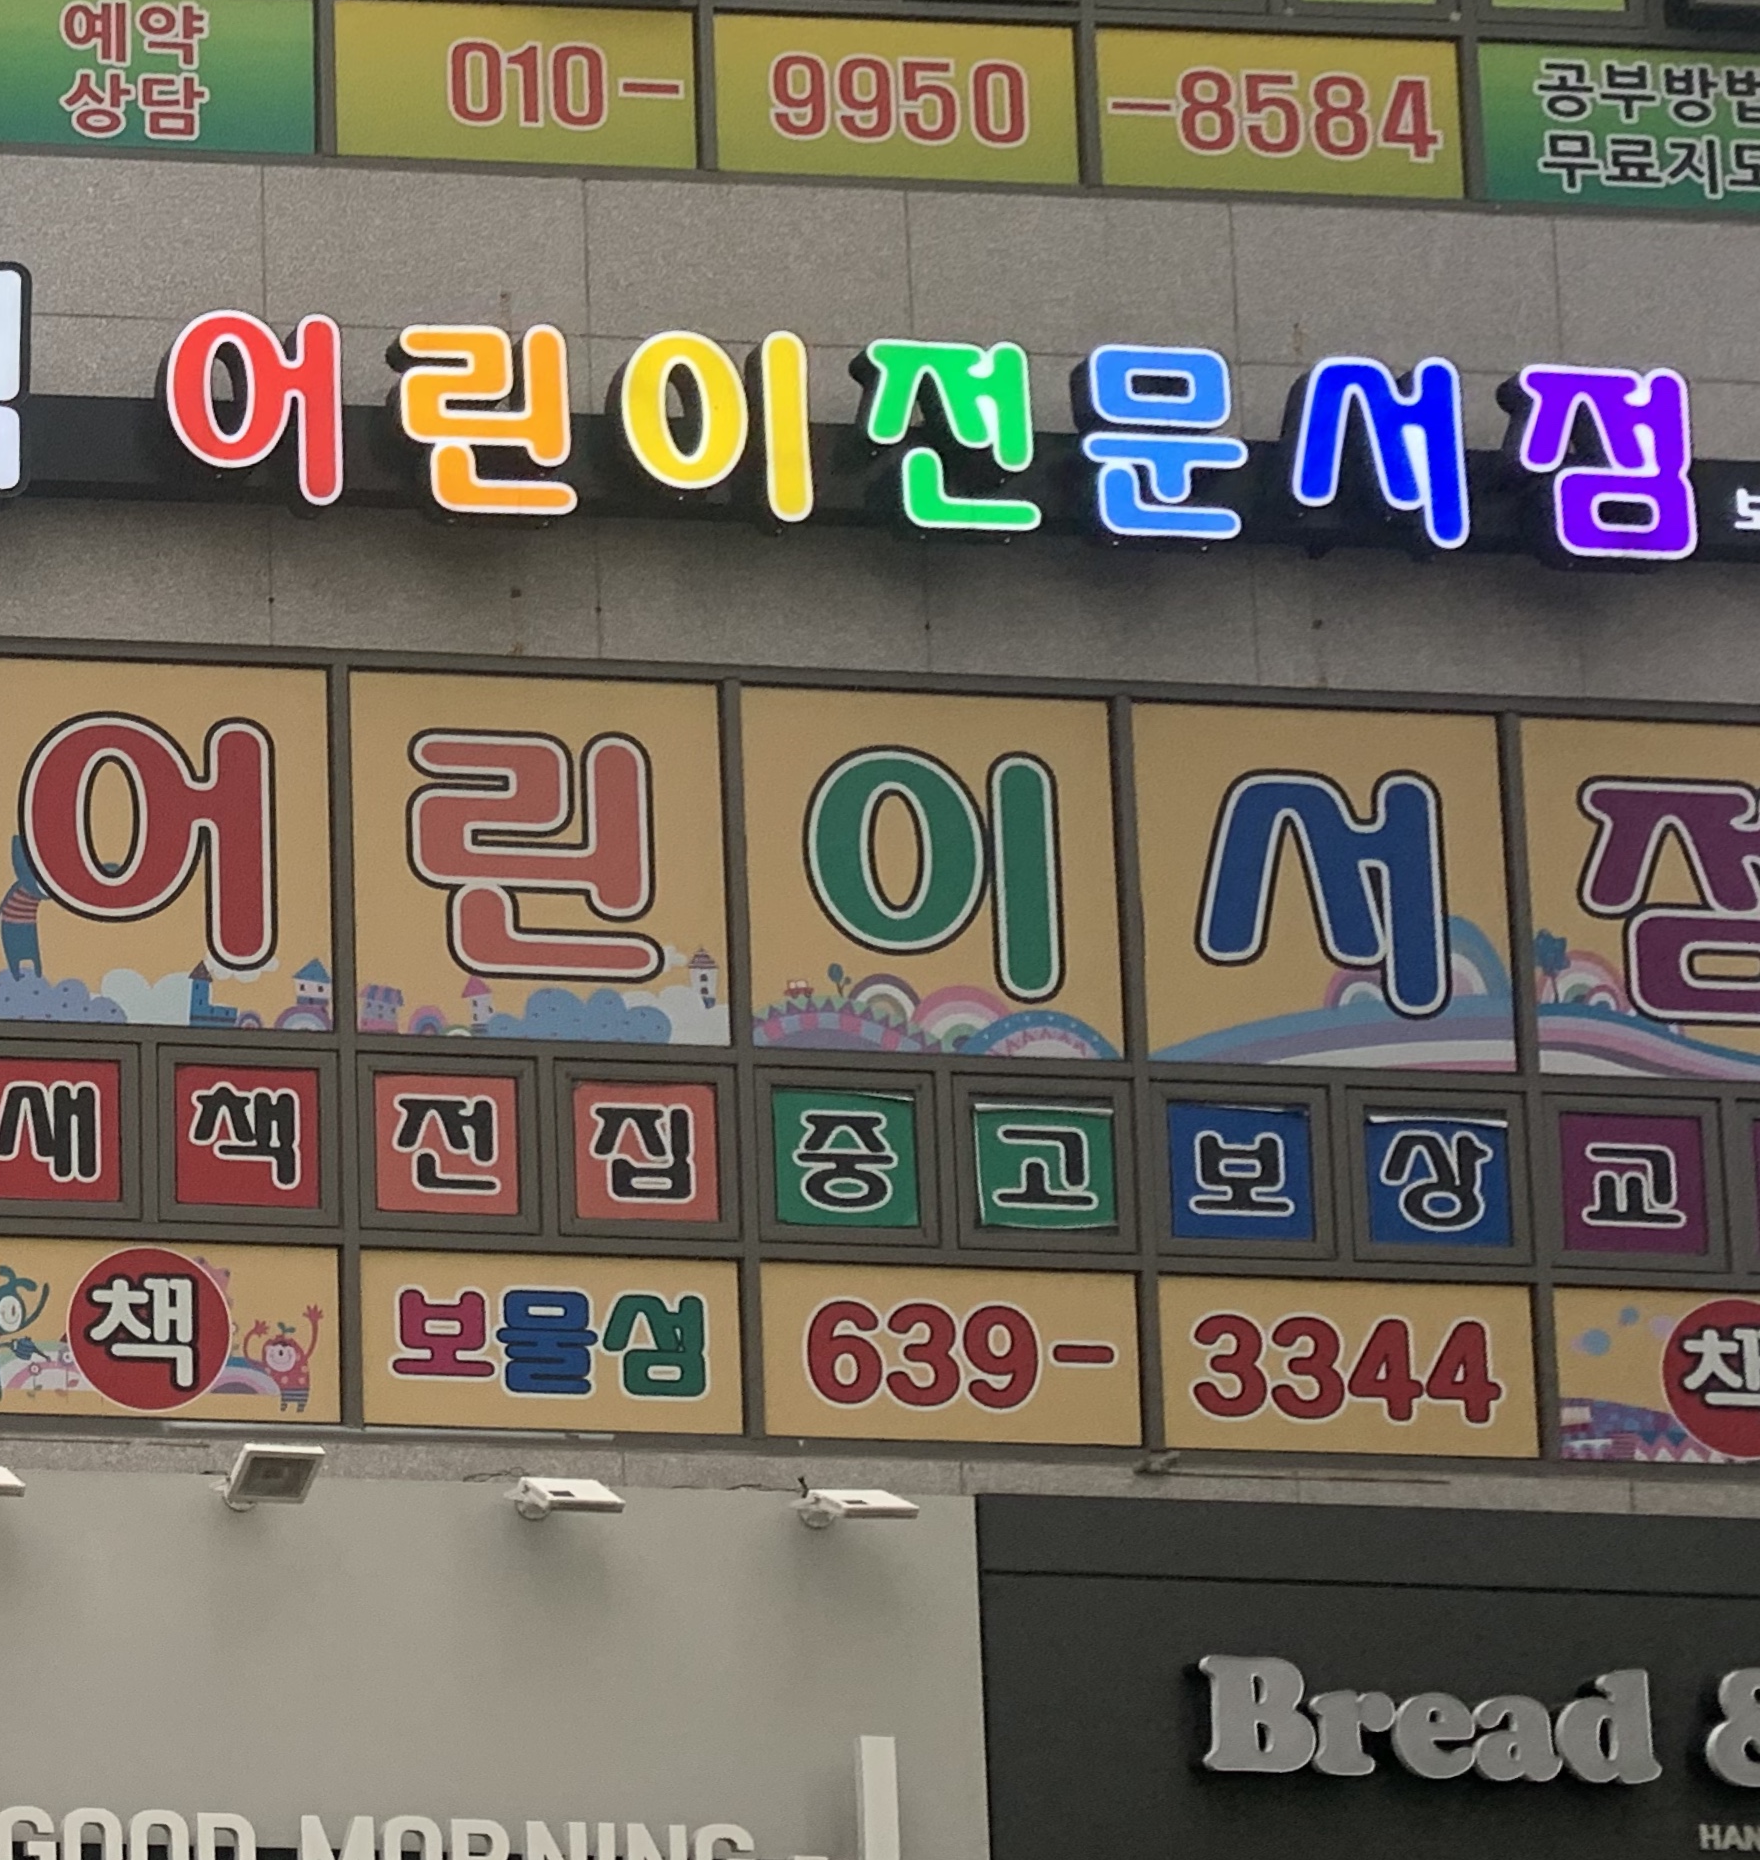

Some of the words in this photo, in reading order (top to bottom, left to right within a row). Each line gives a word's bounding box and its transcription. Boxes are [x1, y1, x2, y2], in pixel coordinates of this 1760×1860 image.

[62, 1, 207, 65] 예약
[62, 70, 207, 139] 상담
[89, 1276, 197, 1391] 책
[394, 1289, 710, 1400] 보물섬
[1199, 1655, 1662, 1784] Bread
